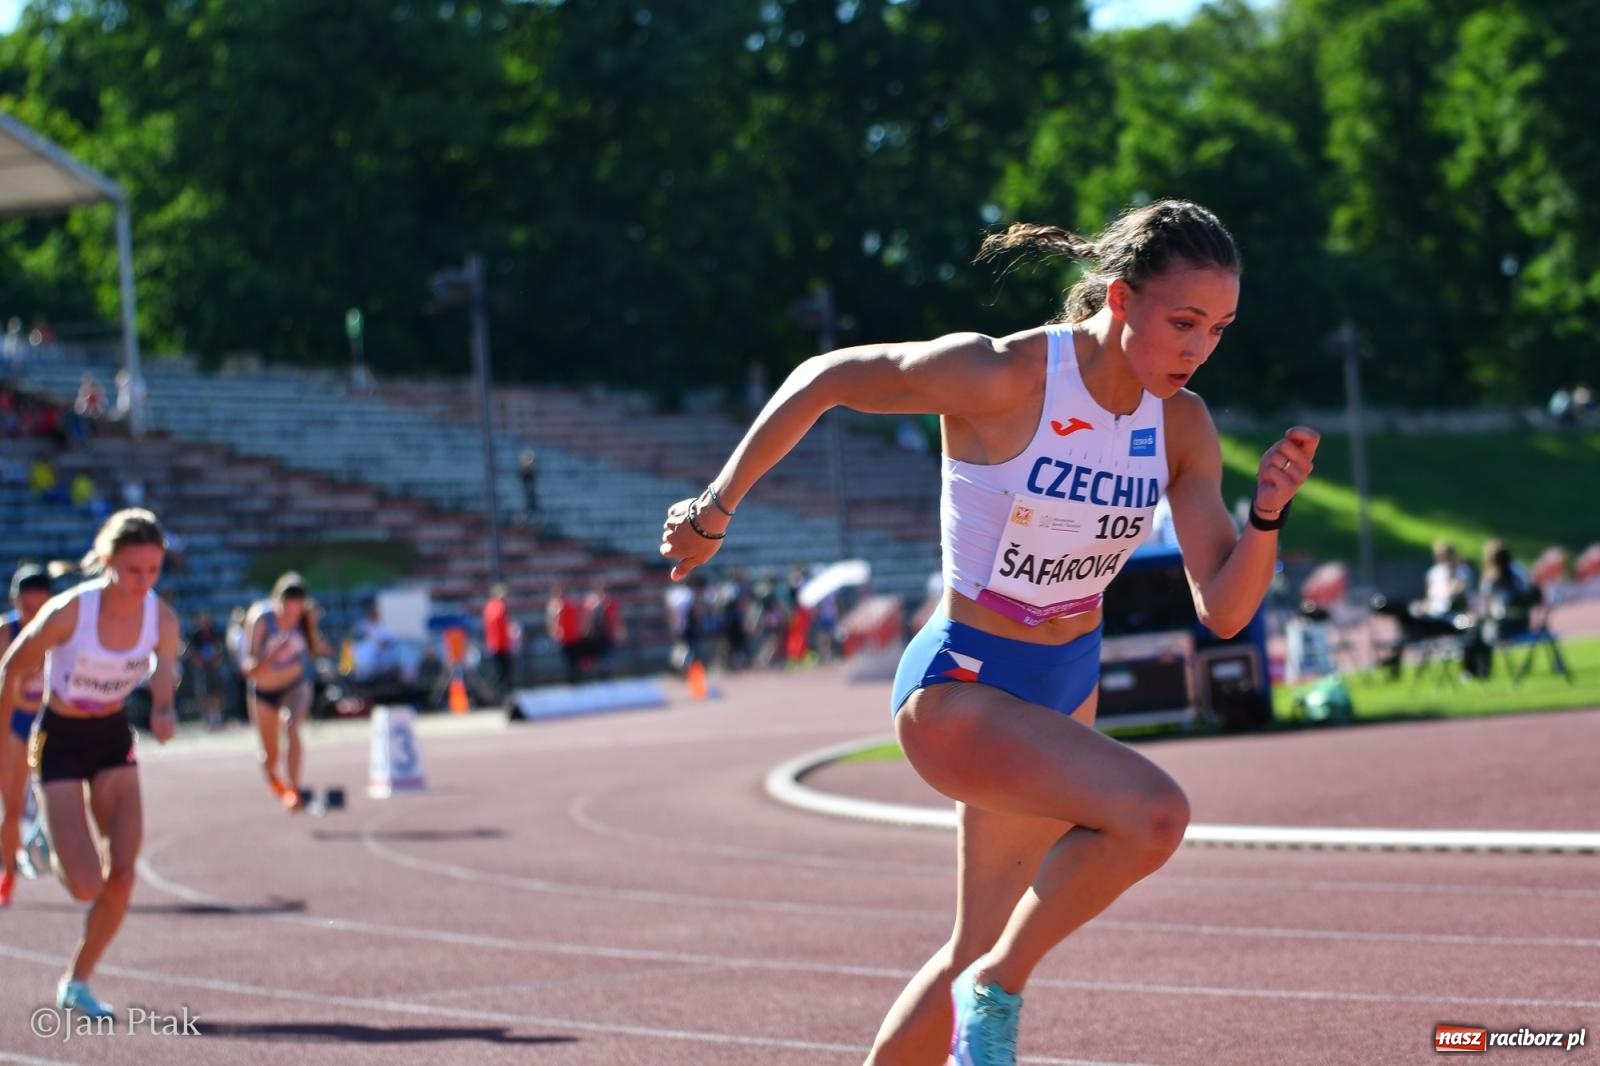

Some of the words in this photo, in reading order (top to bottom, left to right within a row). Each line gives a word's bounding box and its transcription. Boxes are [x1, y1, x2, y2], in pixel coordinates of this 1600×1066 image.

[1026, 456, 1159, 508] CZECHIA
[1095, 514, 1144, 540] 105
[999, 542, 1127, 586] ŠAFÁROVÁ
[391, 723, 417, 776] 3
